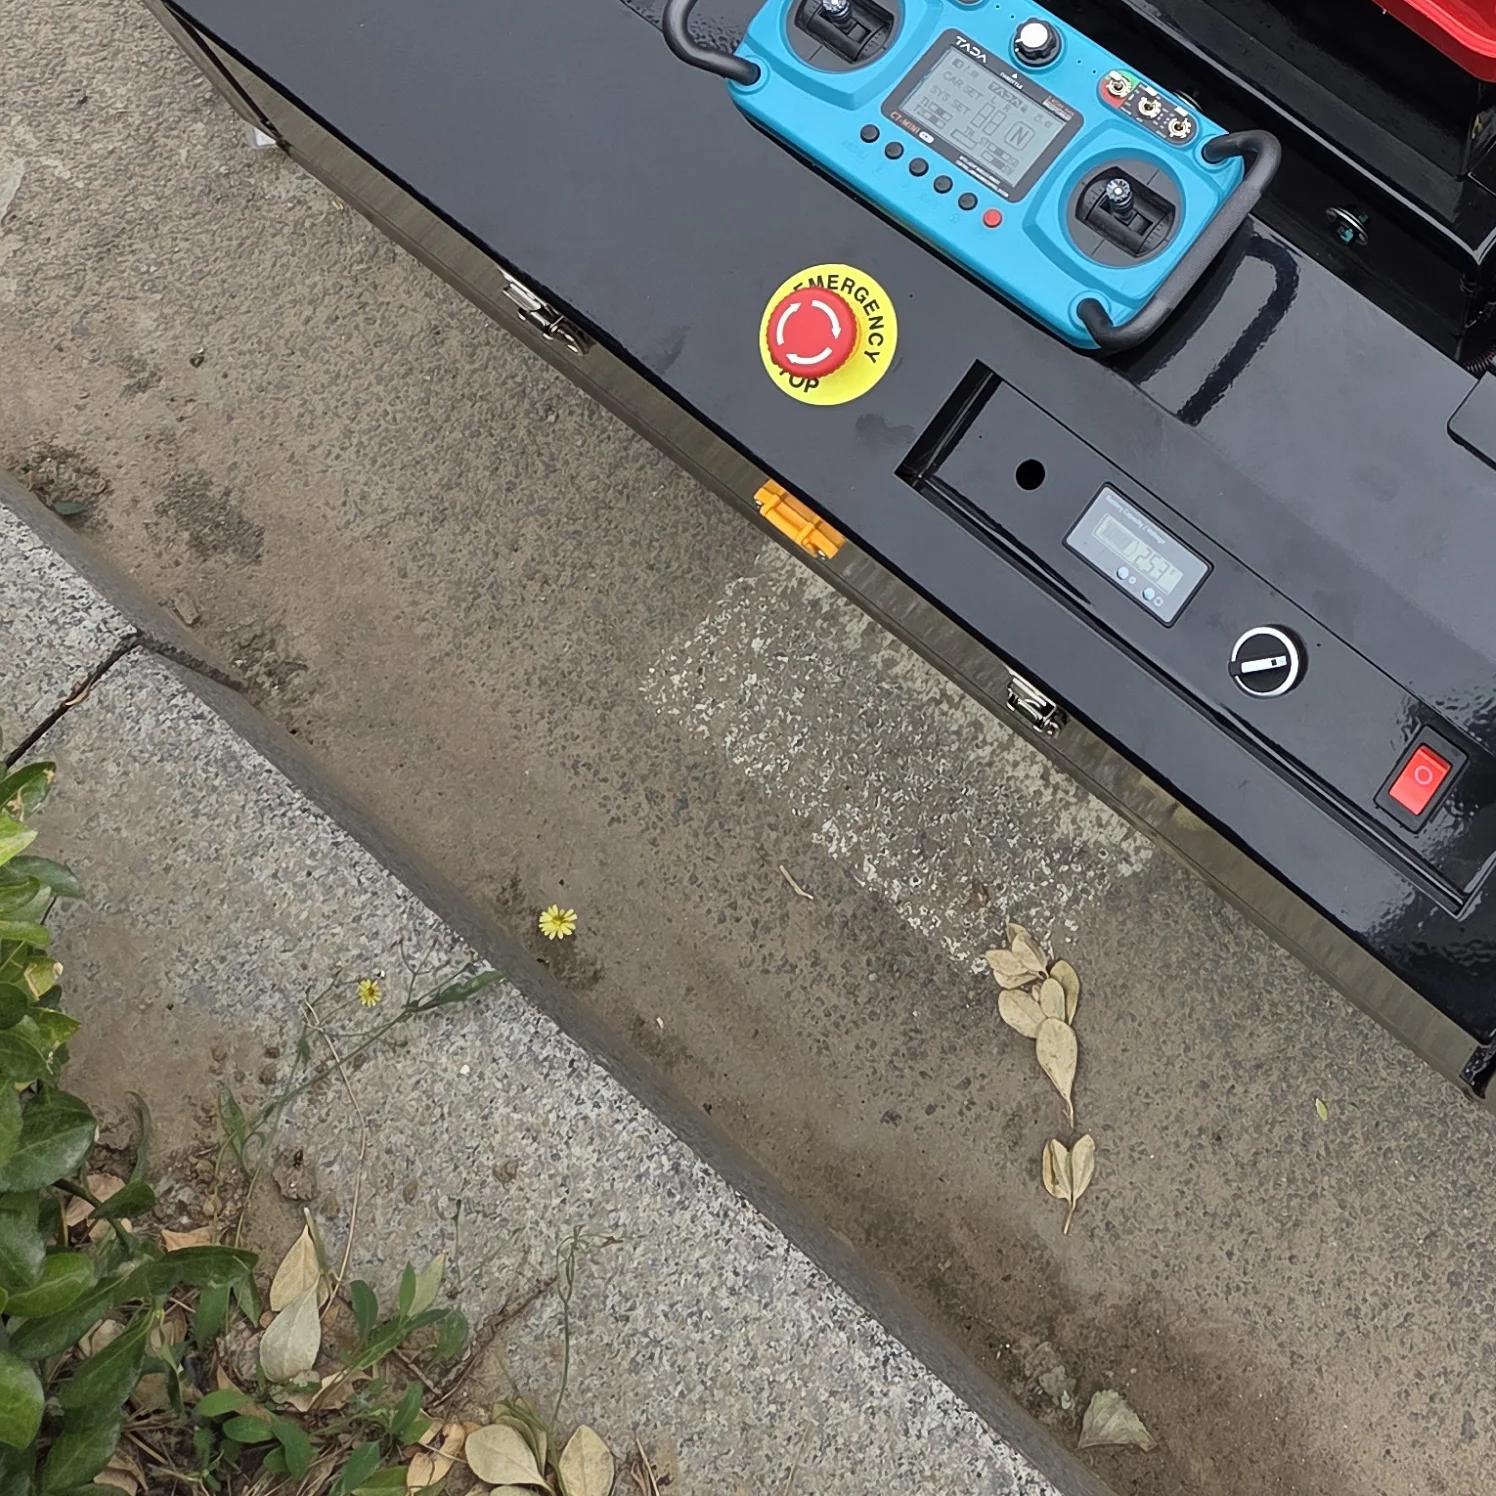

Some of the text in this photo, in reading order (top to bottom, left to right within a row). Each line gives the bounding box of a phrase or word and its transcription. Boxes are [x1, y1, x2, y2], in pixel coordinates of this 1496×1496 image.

[928, 84, 972, 117] SYS SET
[941, 69, 963, 88] CAR
[962, 84, 983, 102] SET
[1008, 125, 1030, 147] N
[793, 274, 885, 364] MERGENCY
